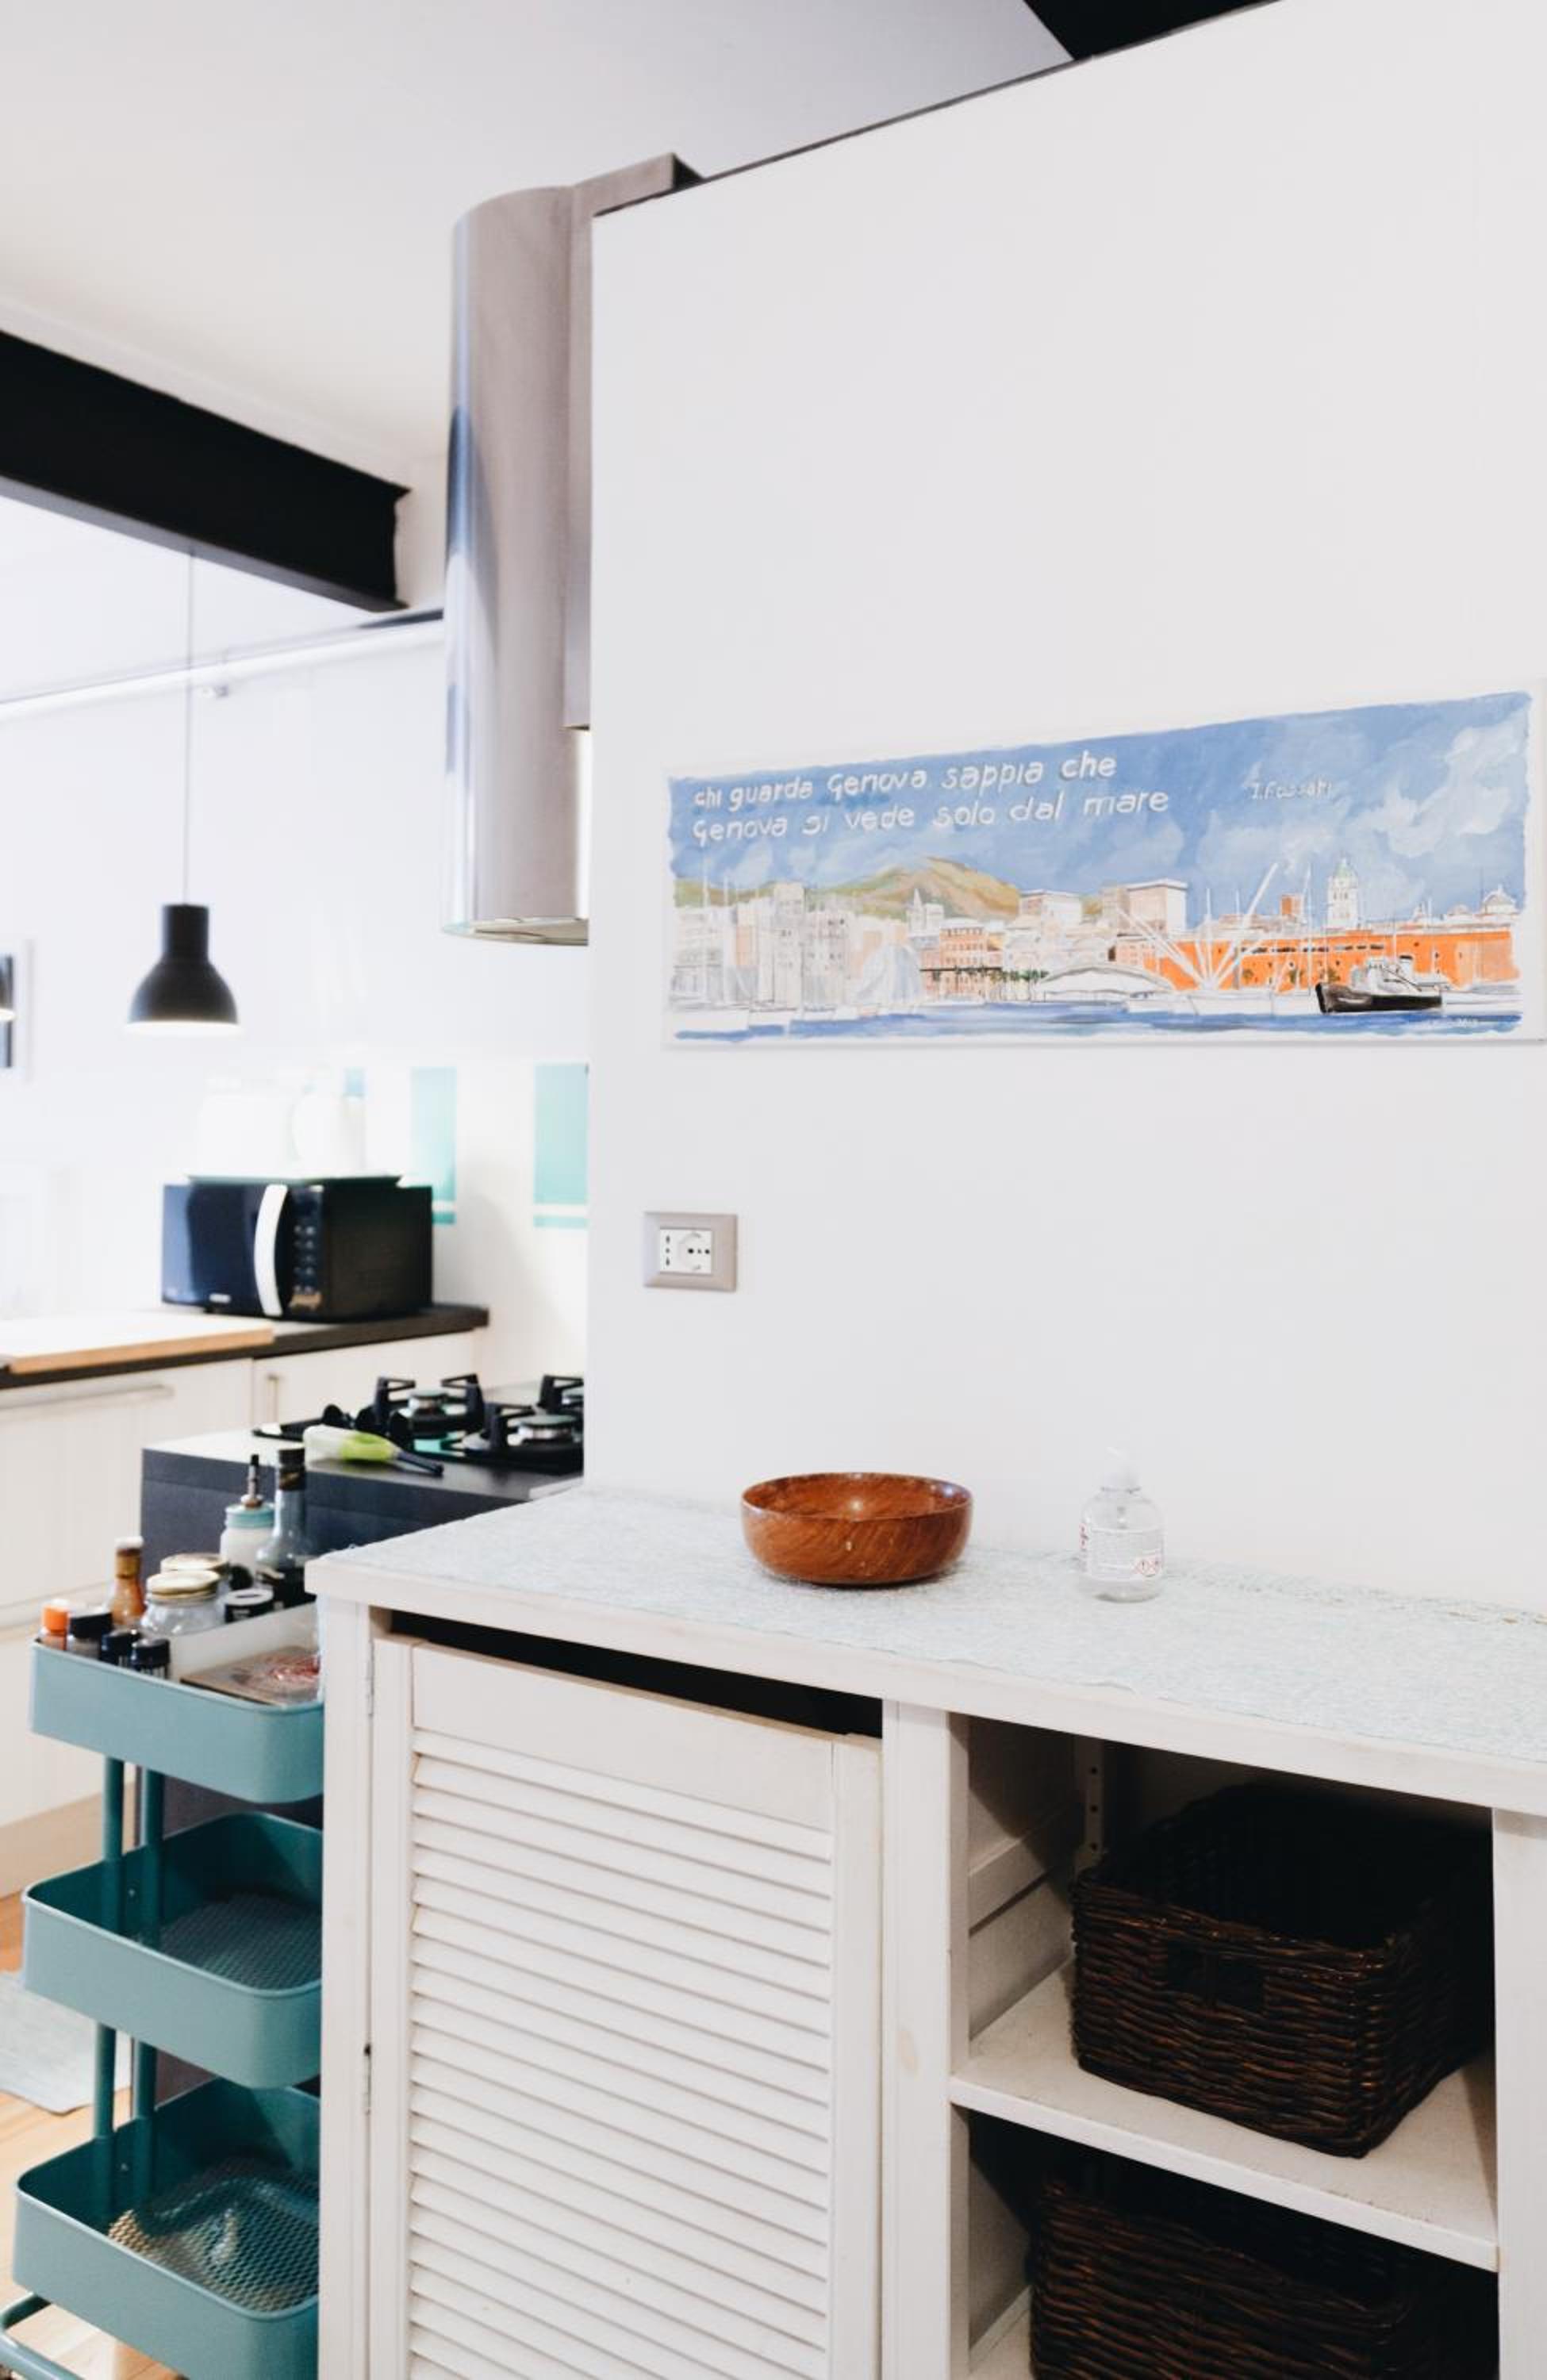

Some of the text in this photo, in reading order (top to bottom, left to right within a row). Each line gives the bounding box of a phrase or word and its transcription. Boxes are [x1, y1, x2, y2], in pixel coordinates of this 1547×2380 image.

[693, 750, 1117, 812] chi guarda Genova sappia che
[693, 789, 1169, 847] Genova si vede solo dal mare
